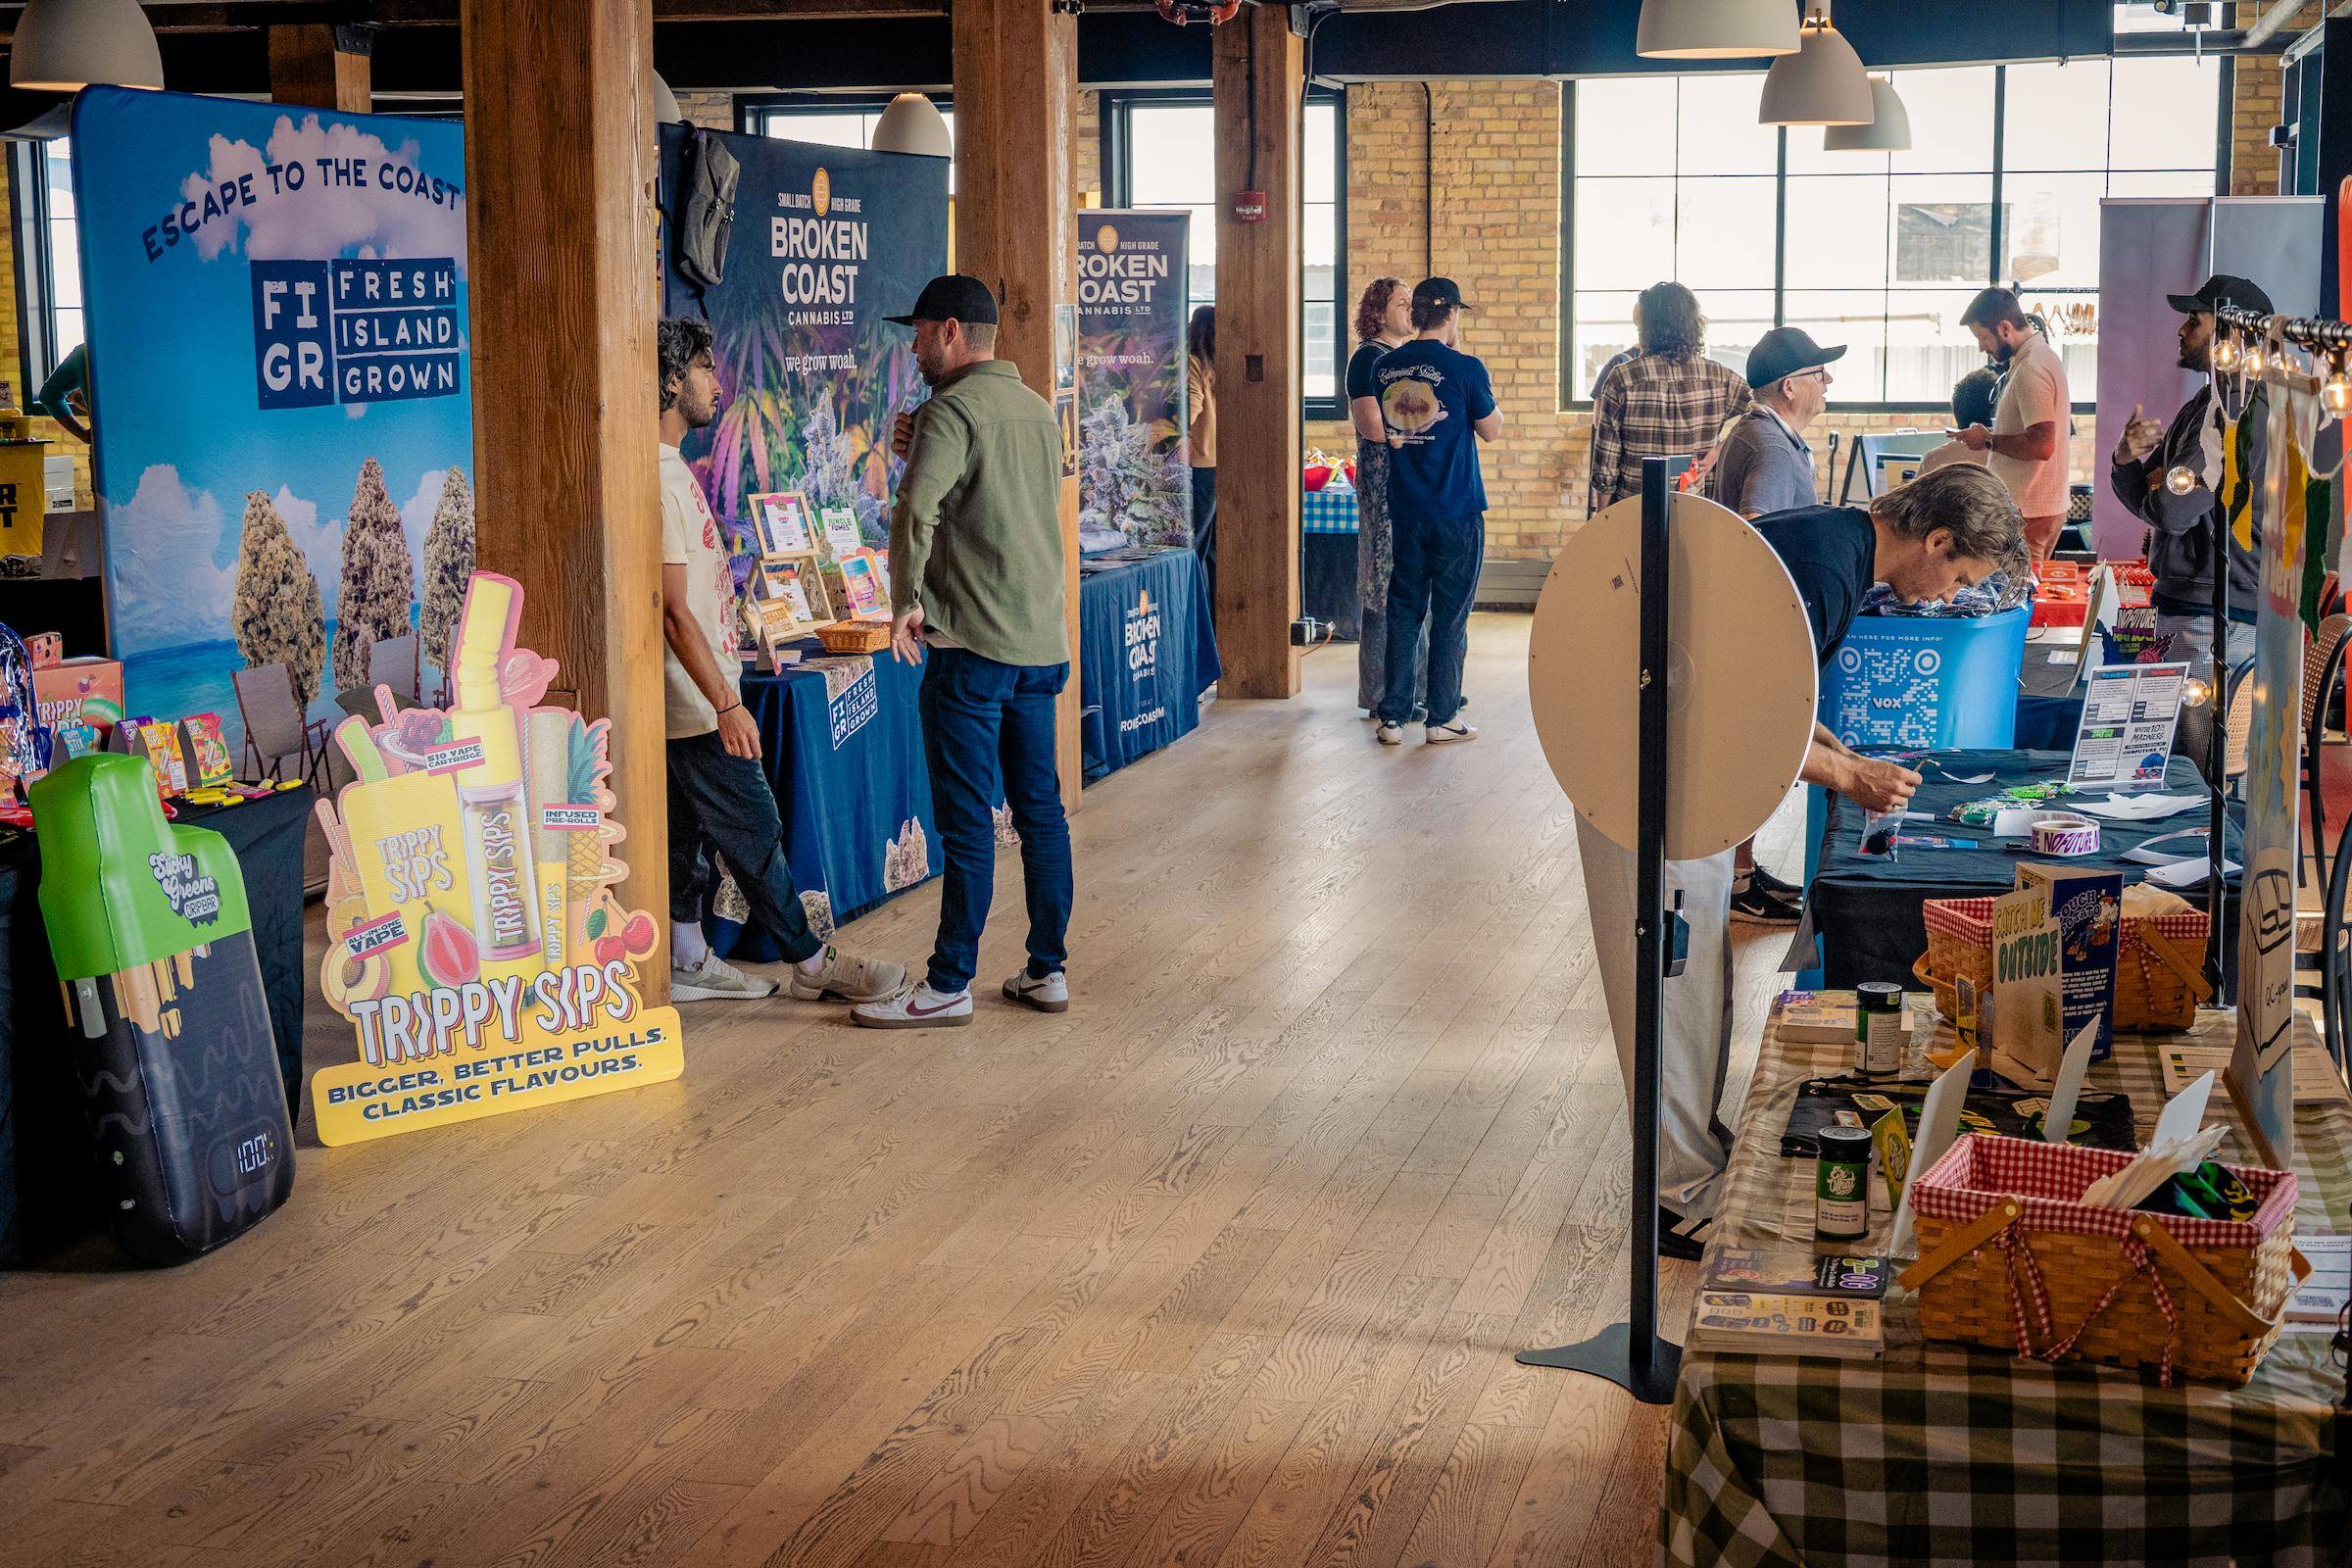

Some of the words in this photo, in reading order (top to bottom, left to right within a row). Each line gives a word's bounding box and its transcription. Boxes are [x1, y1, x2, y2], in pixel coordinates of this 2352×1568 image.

[142, 172, 257, 263] ESCAPE
[266, 161, 306, 196] TO
[317, 158, 367, 187] THE
[378, 163, 461, 211] COAST
[777, 192, 795, 208] SMALL
[796, 194, 811, 209] BATCH
[831, 197, 844, 212] HIGH
[845, 198, 861, 213] GRADE
[771, 216, 868, 261] BROKEN
[1120, 241, 1137, 250] HIGH
[1138, 241, 1159, 251] GRADE
[1077, 254, 1168, 277] ROKEN
[339, 270, 451, 300] FRESH
[782, 263, 858, 304] COAST
[1079, 279, 1156, 304] OAST
[263, 280, 318, 331] FI
[788, 311, 840, 325] CANNABIS
[842, 311, 855, 324] LTD
[1077, 306, 1132, 316] ANNABIS
[342, 316, 452, 348] ISLAND
[263, 341, 325, 391] GR
[785, 355, 801, 372] we
[803, 354, 828, 375] grow
[829, 348, 858, 370] woah.
[1077, 355, 1084, 366] e
[1086, 354, 1117, 367] grow
[1118, 352, 1154, 365] woah.
[345, 363, 455, 396] GROWN
[828, 516, 853, 526] JUNGLE
[1124, 614, 1161, 647] BOKEN
[847, 672, 873, 702] FRESH
[848, 687, 874, 716] ISLAND
[832, 700, 846, 724] FI
[850, 701, 876, 729] GROWN
[1872, 697, 1902, 710] VOX
[834, 717, 848, 741] GR
[427, 753, 448, 762] 510
[450, 744, 481, 758] VAPE
[428, 752, 482, 768] CARTRIDGE
[375, 824, 445, 864] TRIPPY
[481, 811, 516, 860] SIPS
[148, 851, 193, 879] Sticky
[384, 850, 456, 905] SIPS
[162, 874, 216, 911] Greens
[486, 866, 524, 943] TRIPPY
[546, 882, 563, 913] SIPS
[348, 918, 402, 945] ALL-IN-ONE
[1995, 902, 2029, 940] CATCH
[2030, 897, 2046, 929] ME
[2061, 904, 2101, 937] POTATO
[350, 924, 406, 954] VAPE
[546, 916, 564, 963] TRIPPY
[1998, 929, 2058, 985] OUTSIDE
[350, 974, 527, 1068] TRIPPY
[534, 959, 638, 1034] SIPS
[327, 1069, 446, 1105] BIGGER,
[454, 1047, 565, 1080] BETTER
[572, 1027, 668, 1058] PULLS.
[362, 1085, 482, 1121] CLASSIC
[491, 1055, 643, 1097] FLAVOURS.
